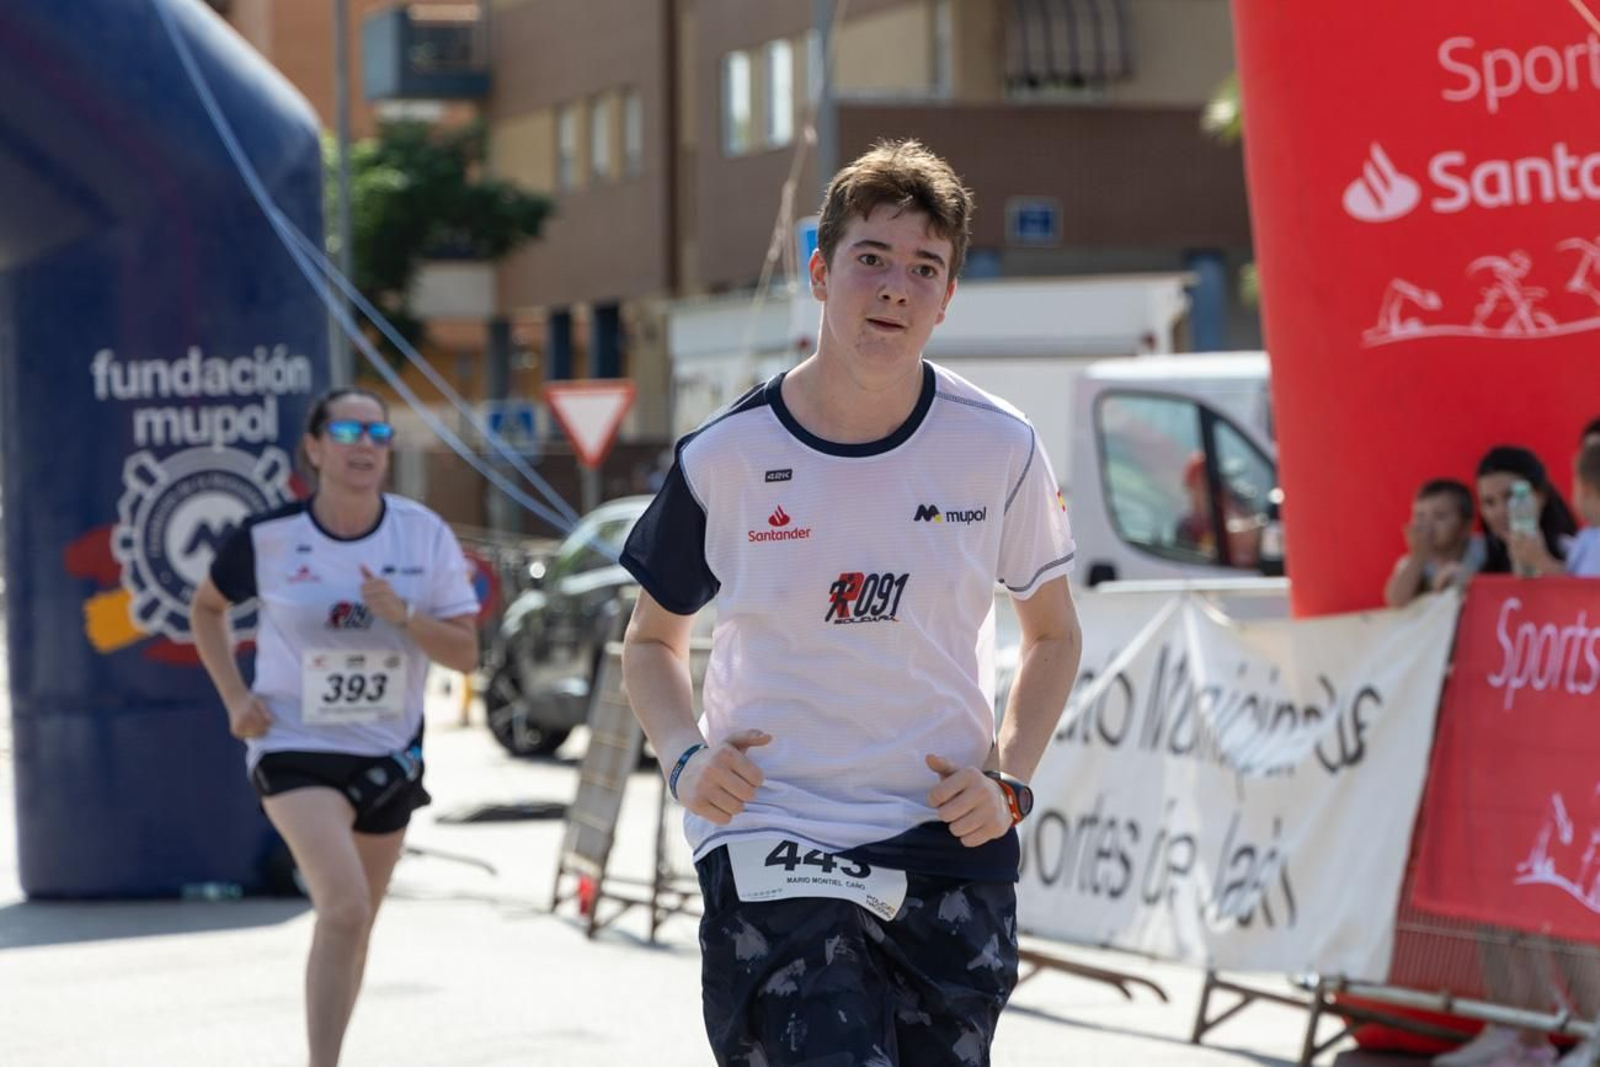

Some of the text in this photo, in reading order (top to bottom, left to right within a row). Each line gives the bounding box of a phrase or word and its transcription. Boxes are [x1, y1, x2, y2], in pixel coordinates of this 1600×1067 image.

[91, 343, 311, 399] fundación
[133, 394, 278, 453] mupol
[748, 528, 811, 542] Santander
[946, 506, 987, 525] mupol
[1487, 597, 1600, 710] Sports
[323, 674, 388, 704] 393
[765, 840, 871, 879] 443
